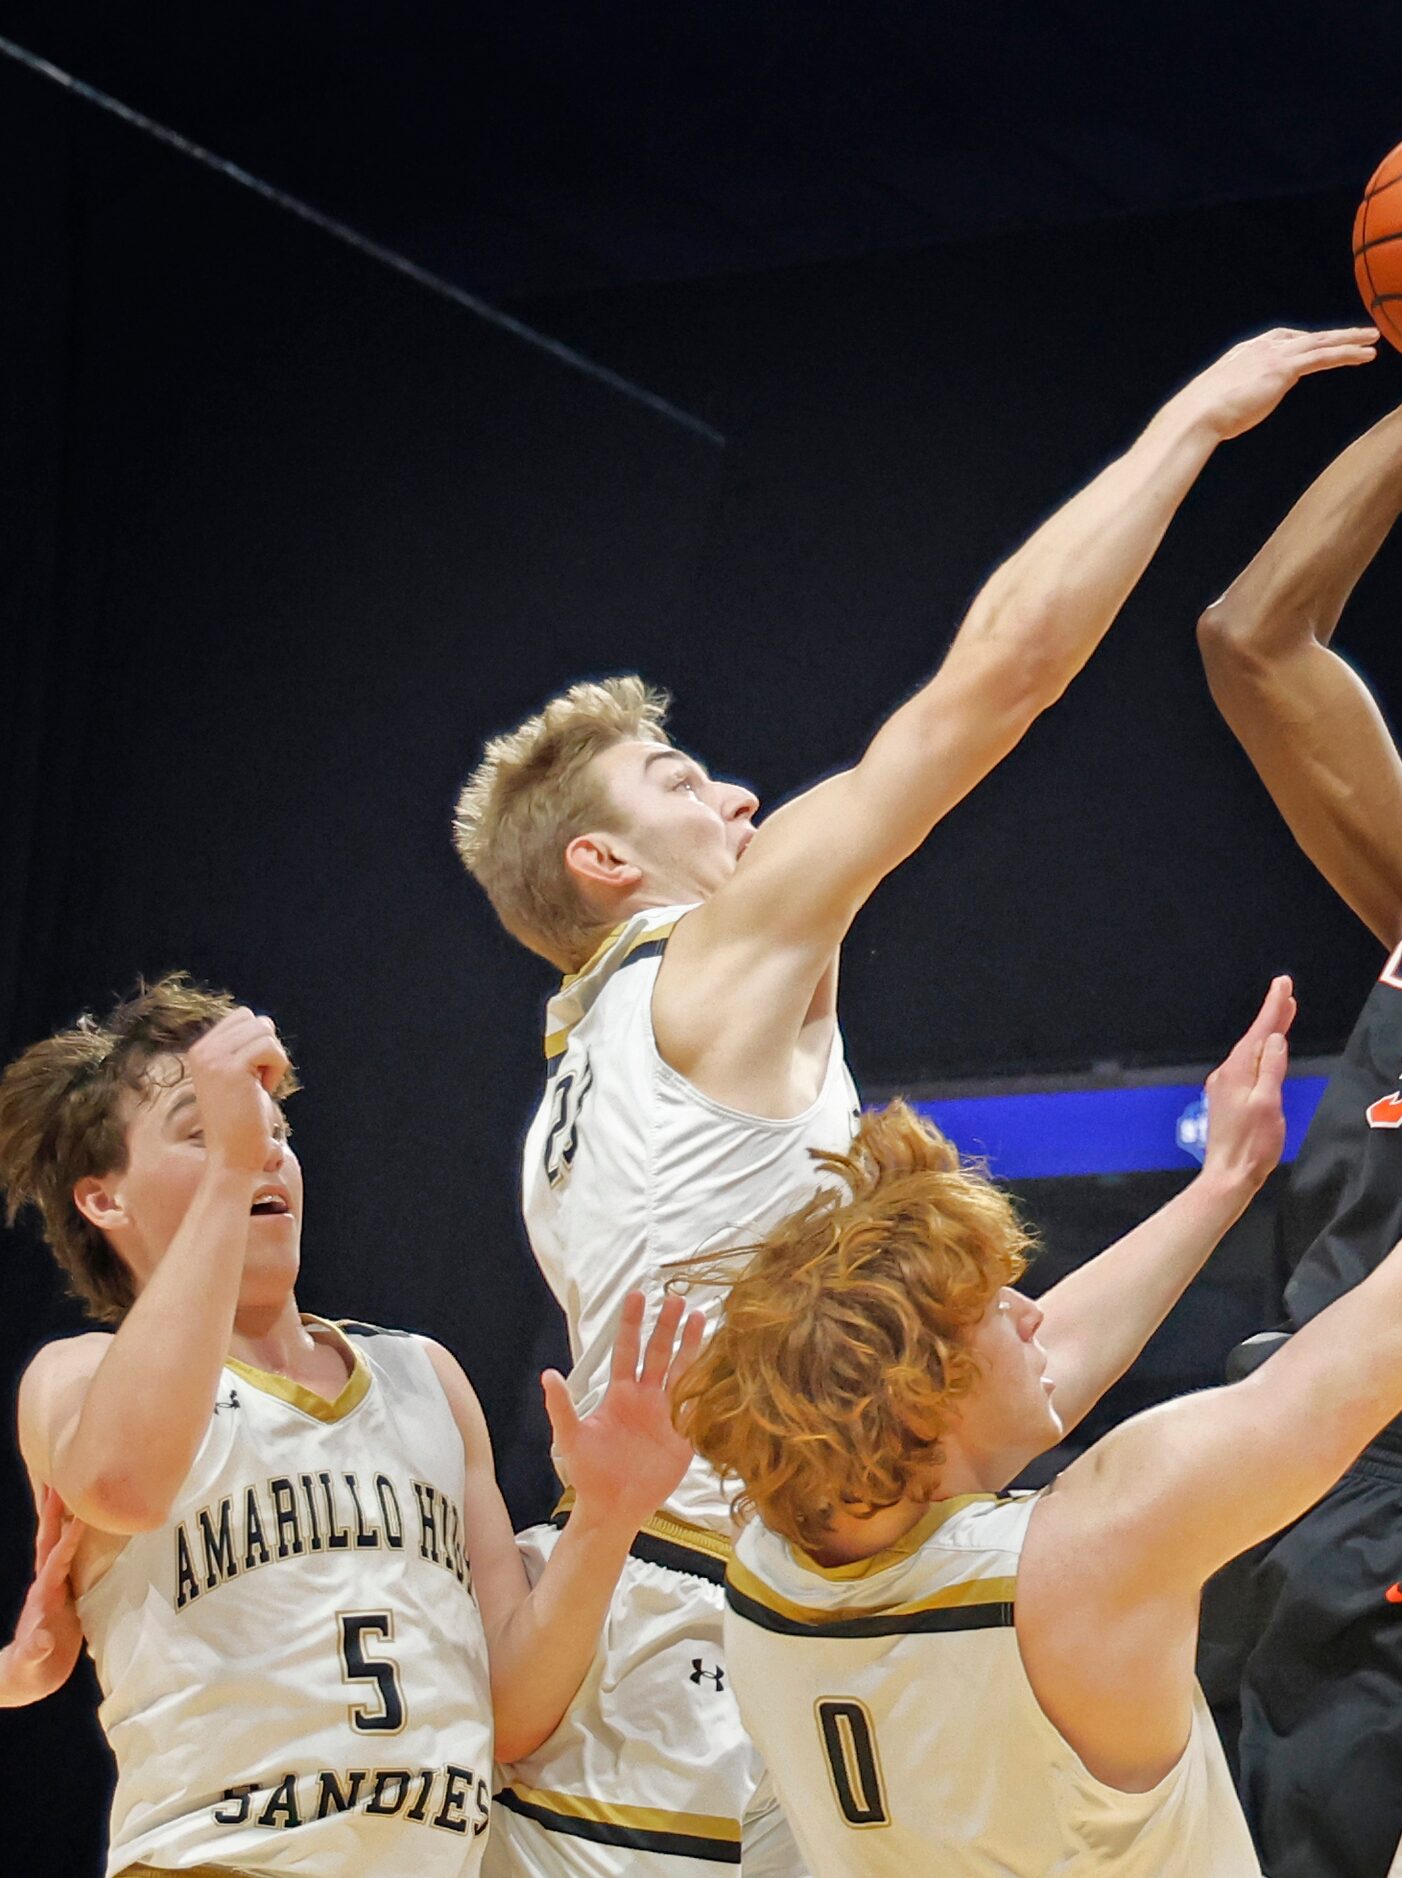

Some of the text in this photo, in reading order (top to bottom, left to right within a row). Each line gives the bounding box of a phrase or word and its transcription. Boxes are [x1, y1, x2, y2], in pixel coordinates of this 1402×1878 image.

[174, 1470, 404, 1614] AMARILLO
[335, 1608, 408, 1736] 5
[813, 1695, 892, 1830] 0
